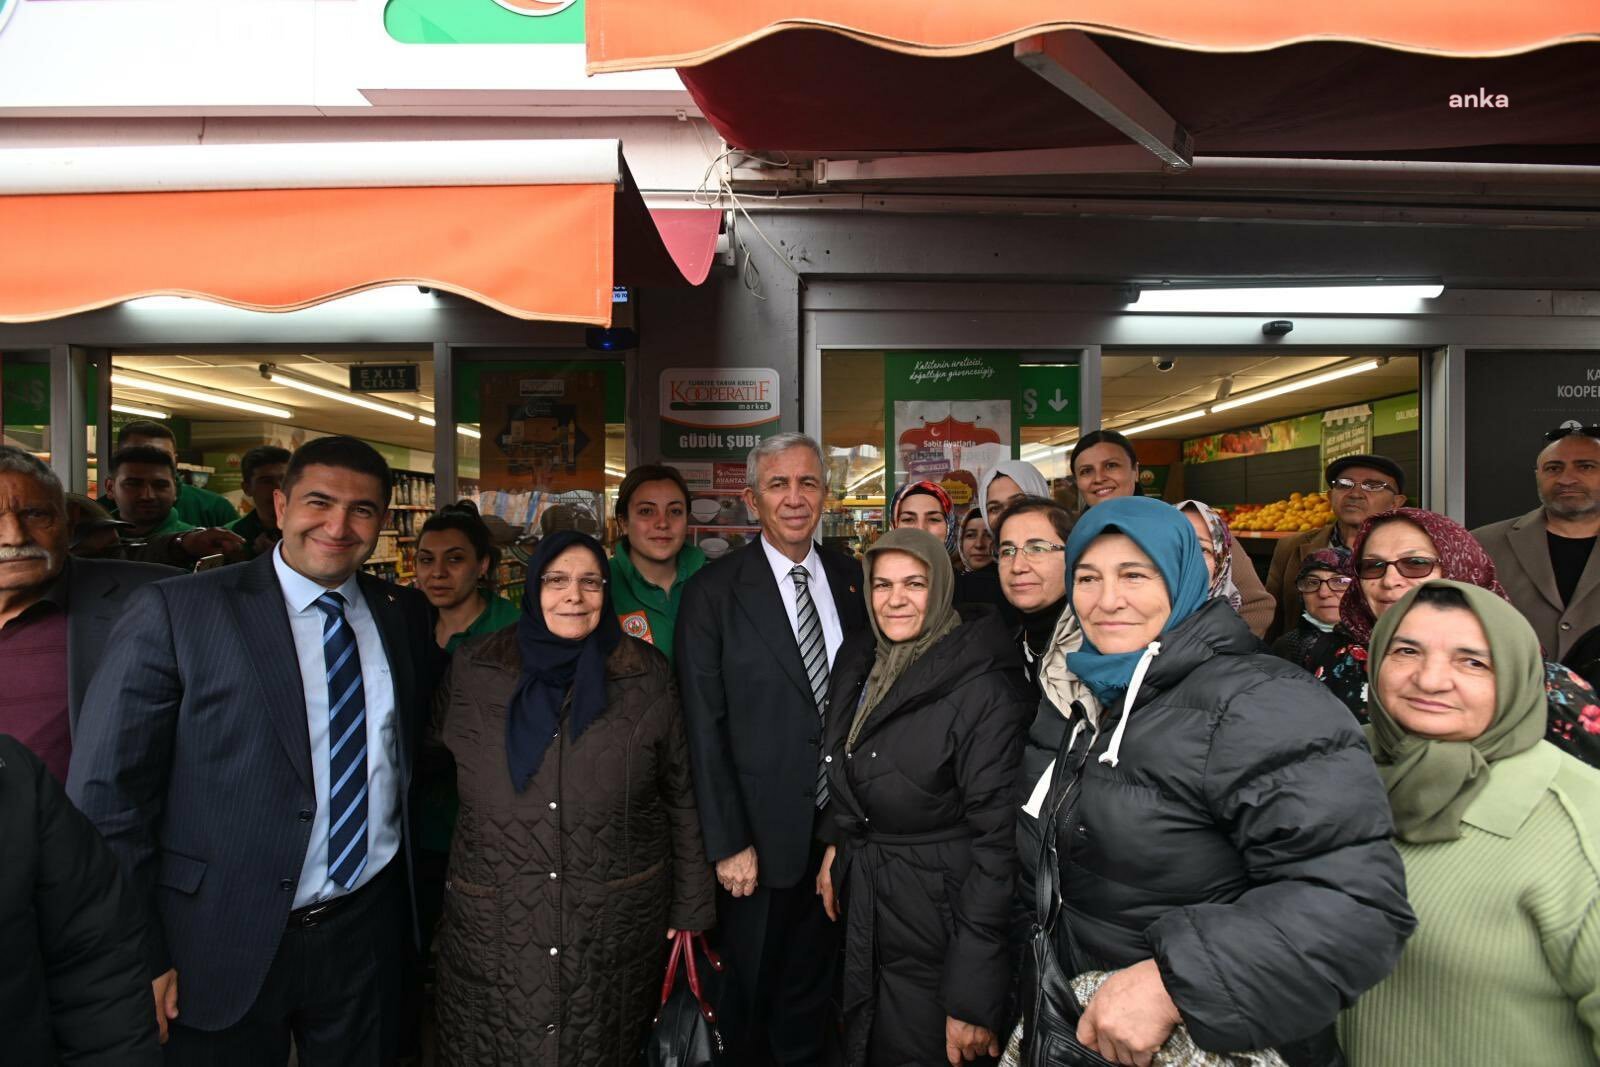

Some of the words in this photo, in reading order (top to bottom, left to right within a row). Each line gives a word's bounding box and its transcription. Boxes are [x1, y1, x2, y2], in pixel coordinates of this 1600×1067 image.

[360, 369, 406, 379] EXIT
[669, 380, 770, 402] KOOPERATİF
[738, 402, 769, 410] market
[679, 433, 724, 448] GÜDÜL
[923, 440, 942, 448] Sabit
[943, 440, 976, 449] fiyatlarla
